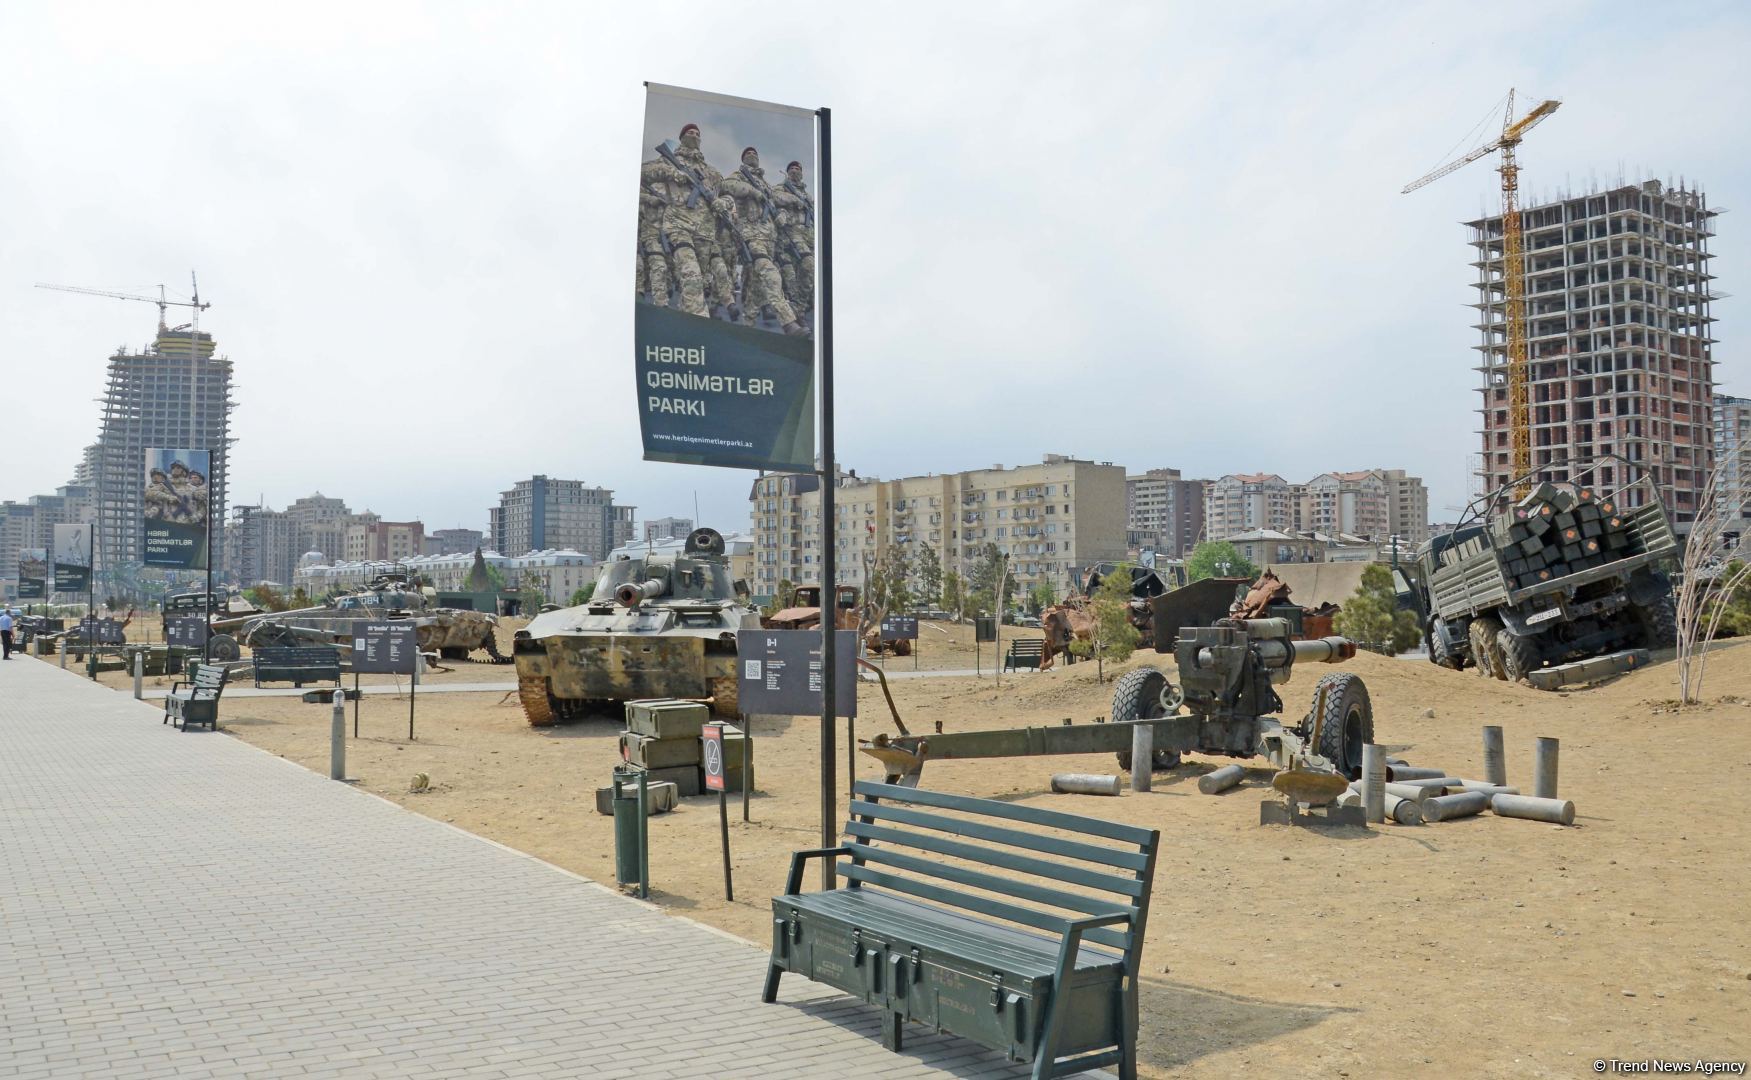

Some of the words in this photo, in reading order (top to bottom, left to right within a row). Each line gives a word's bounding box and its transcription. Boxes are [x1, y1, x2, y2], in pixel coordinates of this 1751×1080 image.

[646, 345, 705, 366] HƏRBİ
[647, 370, 774, 396] QƏNİMƏTLƏR
[649, 397, 706, 417] PARKI
[652, 433, 753, 448] www.herbiqenimetlerparki.az
